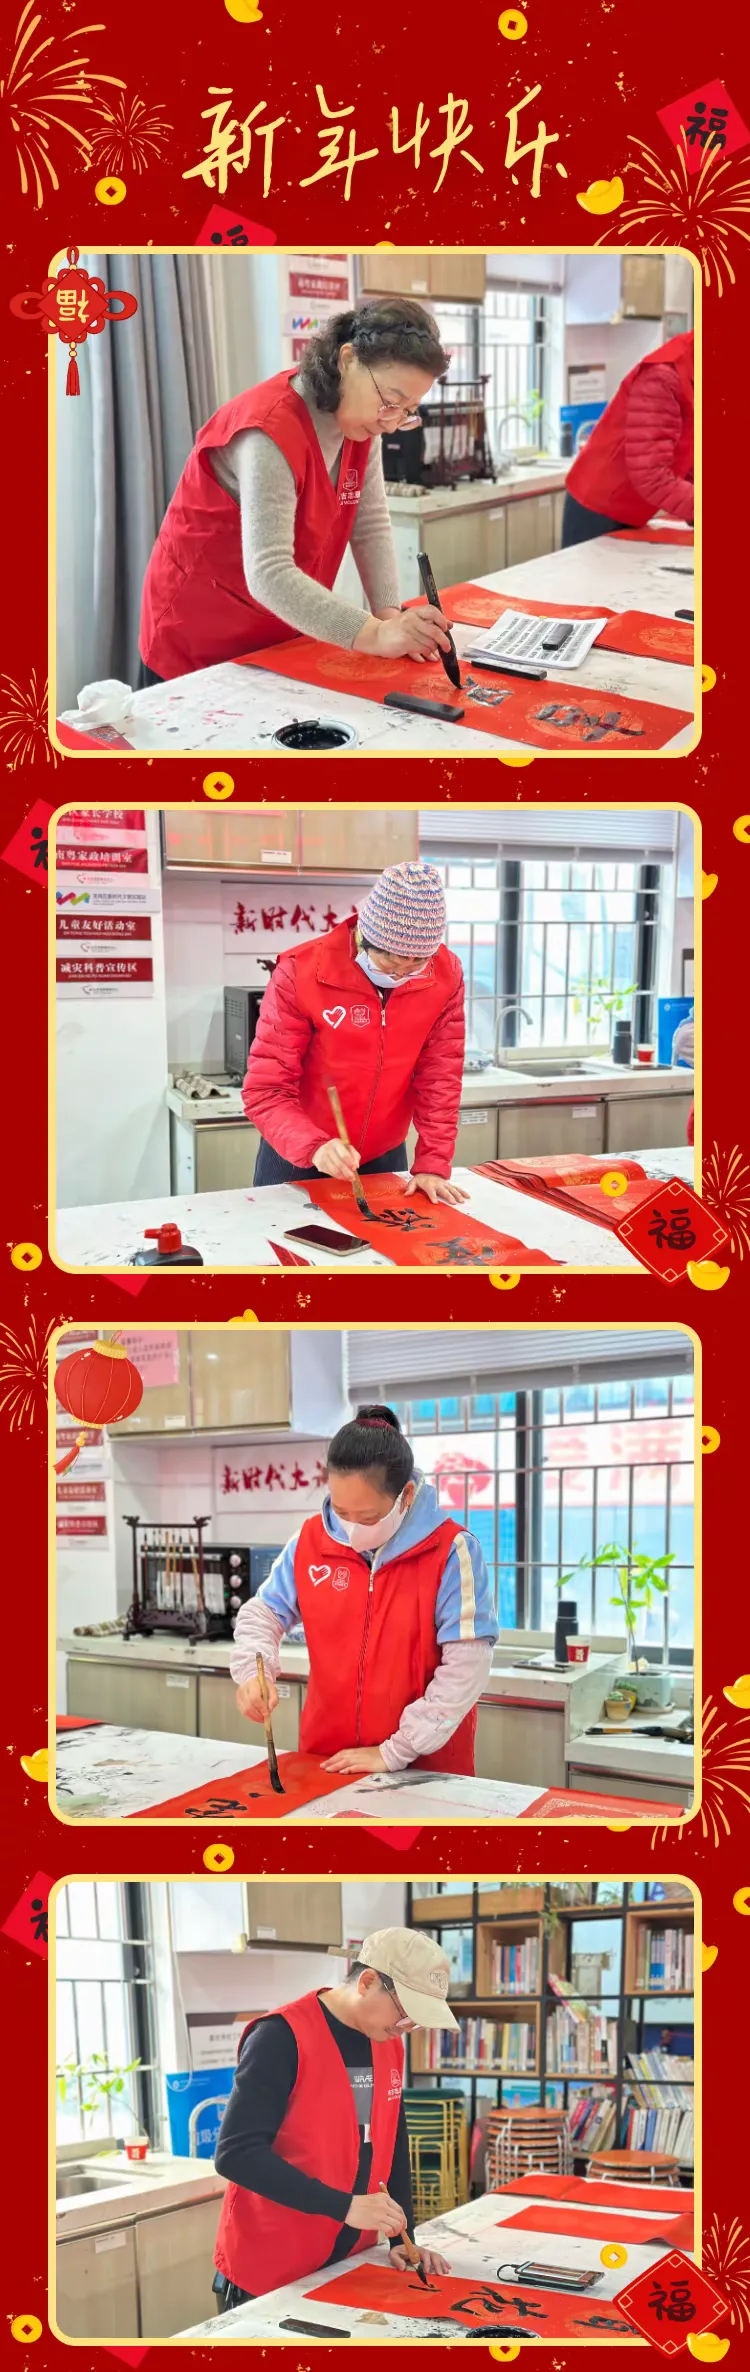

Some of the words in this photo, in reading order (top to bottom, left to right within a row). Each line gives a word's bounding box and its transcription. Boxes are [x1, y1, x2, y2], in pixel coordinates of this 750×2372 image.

[230, 901, 358, 935] 新时代大
[59, 919, 136, 931] 儿童友好活动室
[60, 962, 138, 973] 减灾科普宣传区
